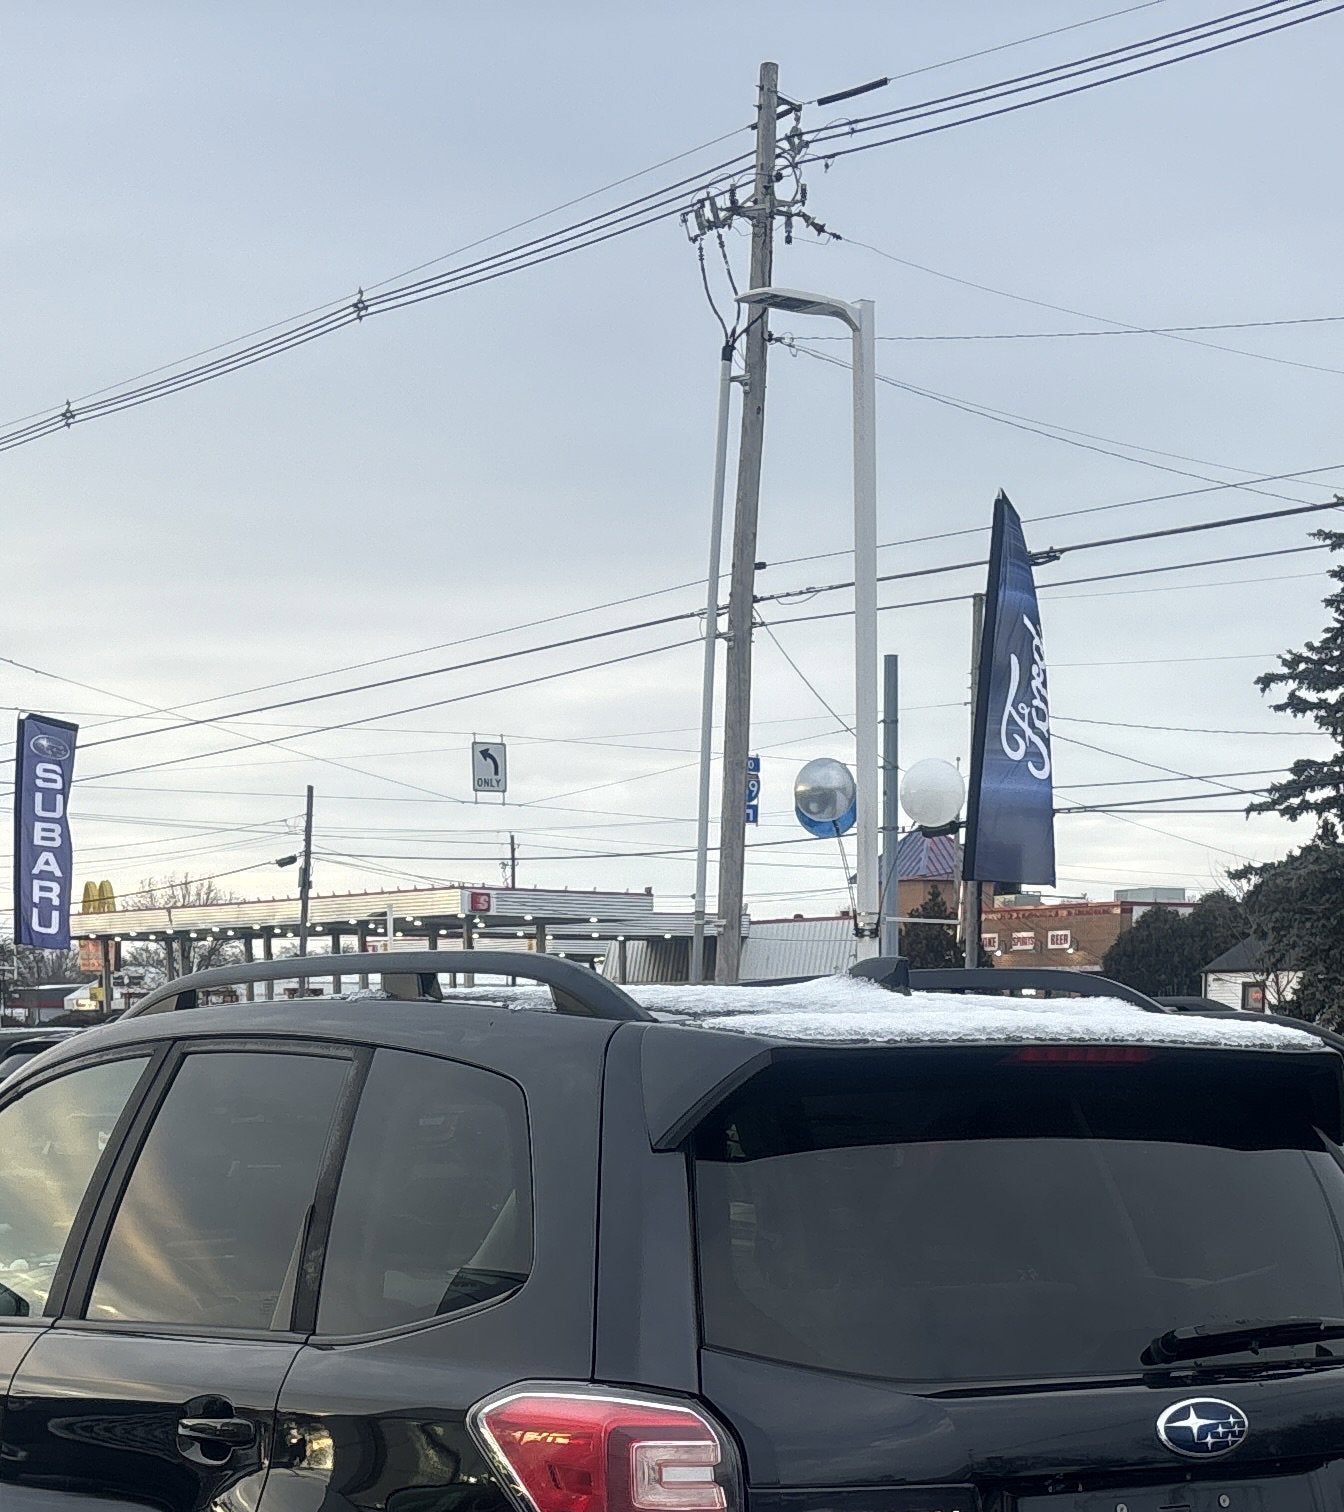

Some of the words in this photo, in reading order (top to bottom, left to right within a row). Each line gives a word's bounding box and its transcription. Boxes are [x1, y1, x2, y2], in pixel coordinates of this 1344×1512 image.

[476, 777, 502, 788] ONLY
[31, 763, 64, 935] SUBARU
[1050, 933, 1069, 946] BEER
